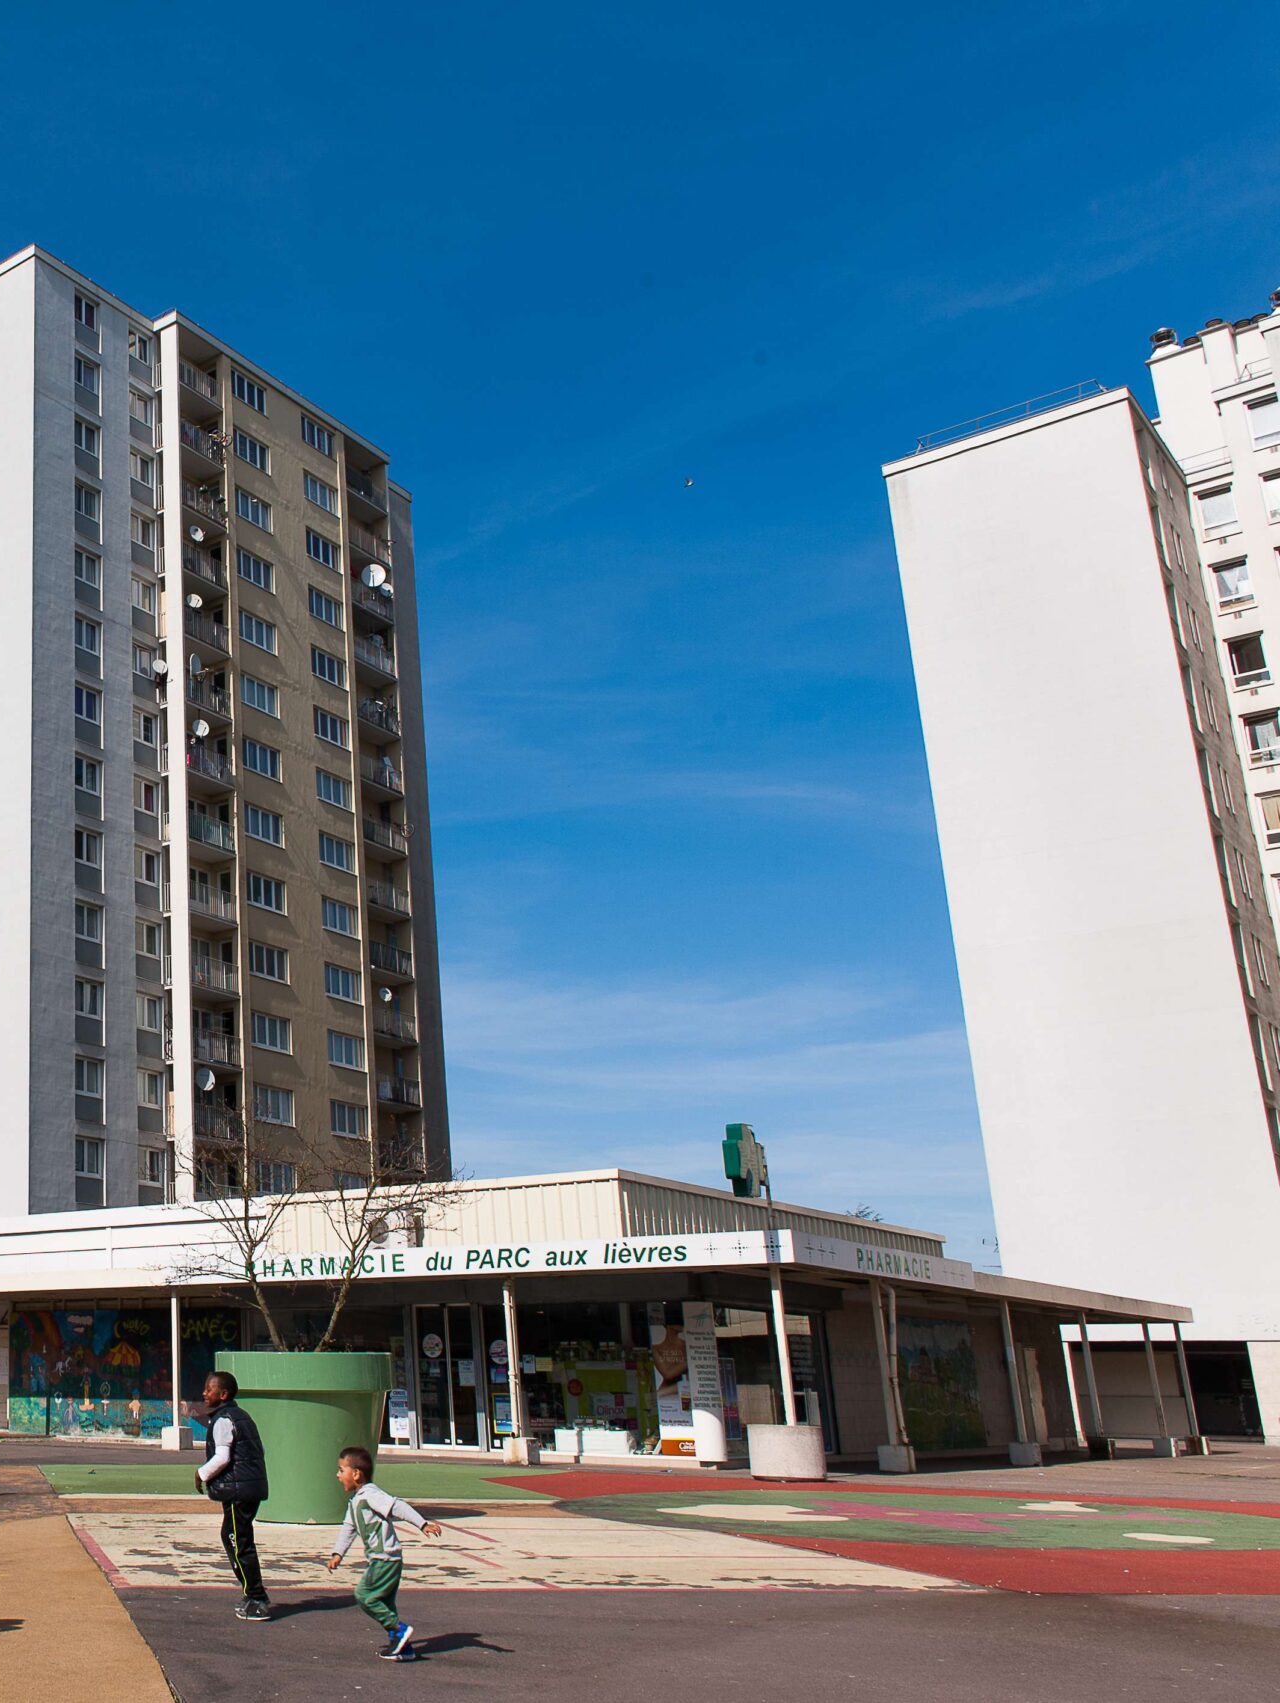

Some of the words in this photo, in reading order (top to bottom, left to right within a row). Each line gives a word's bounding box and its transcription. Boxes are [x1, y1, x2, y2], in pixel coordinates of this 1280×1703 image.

[245, 1253, 405, 1277] PHARMACIE
[425, 1252, 453, 1271] du
[465, 1247, 531, 1270] PARC
[545, 1249, 588, 1267] aux
[603, 1243, 688, 1264] lièvres
[856, 1247, 932, 1280] PHARMACIE
